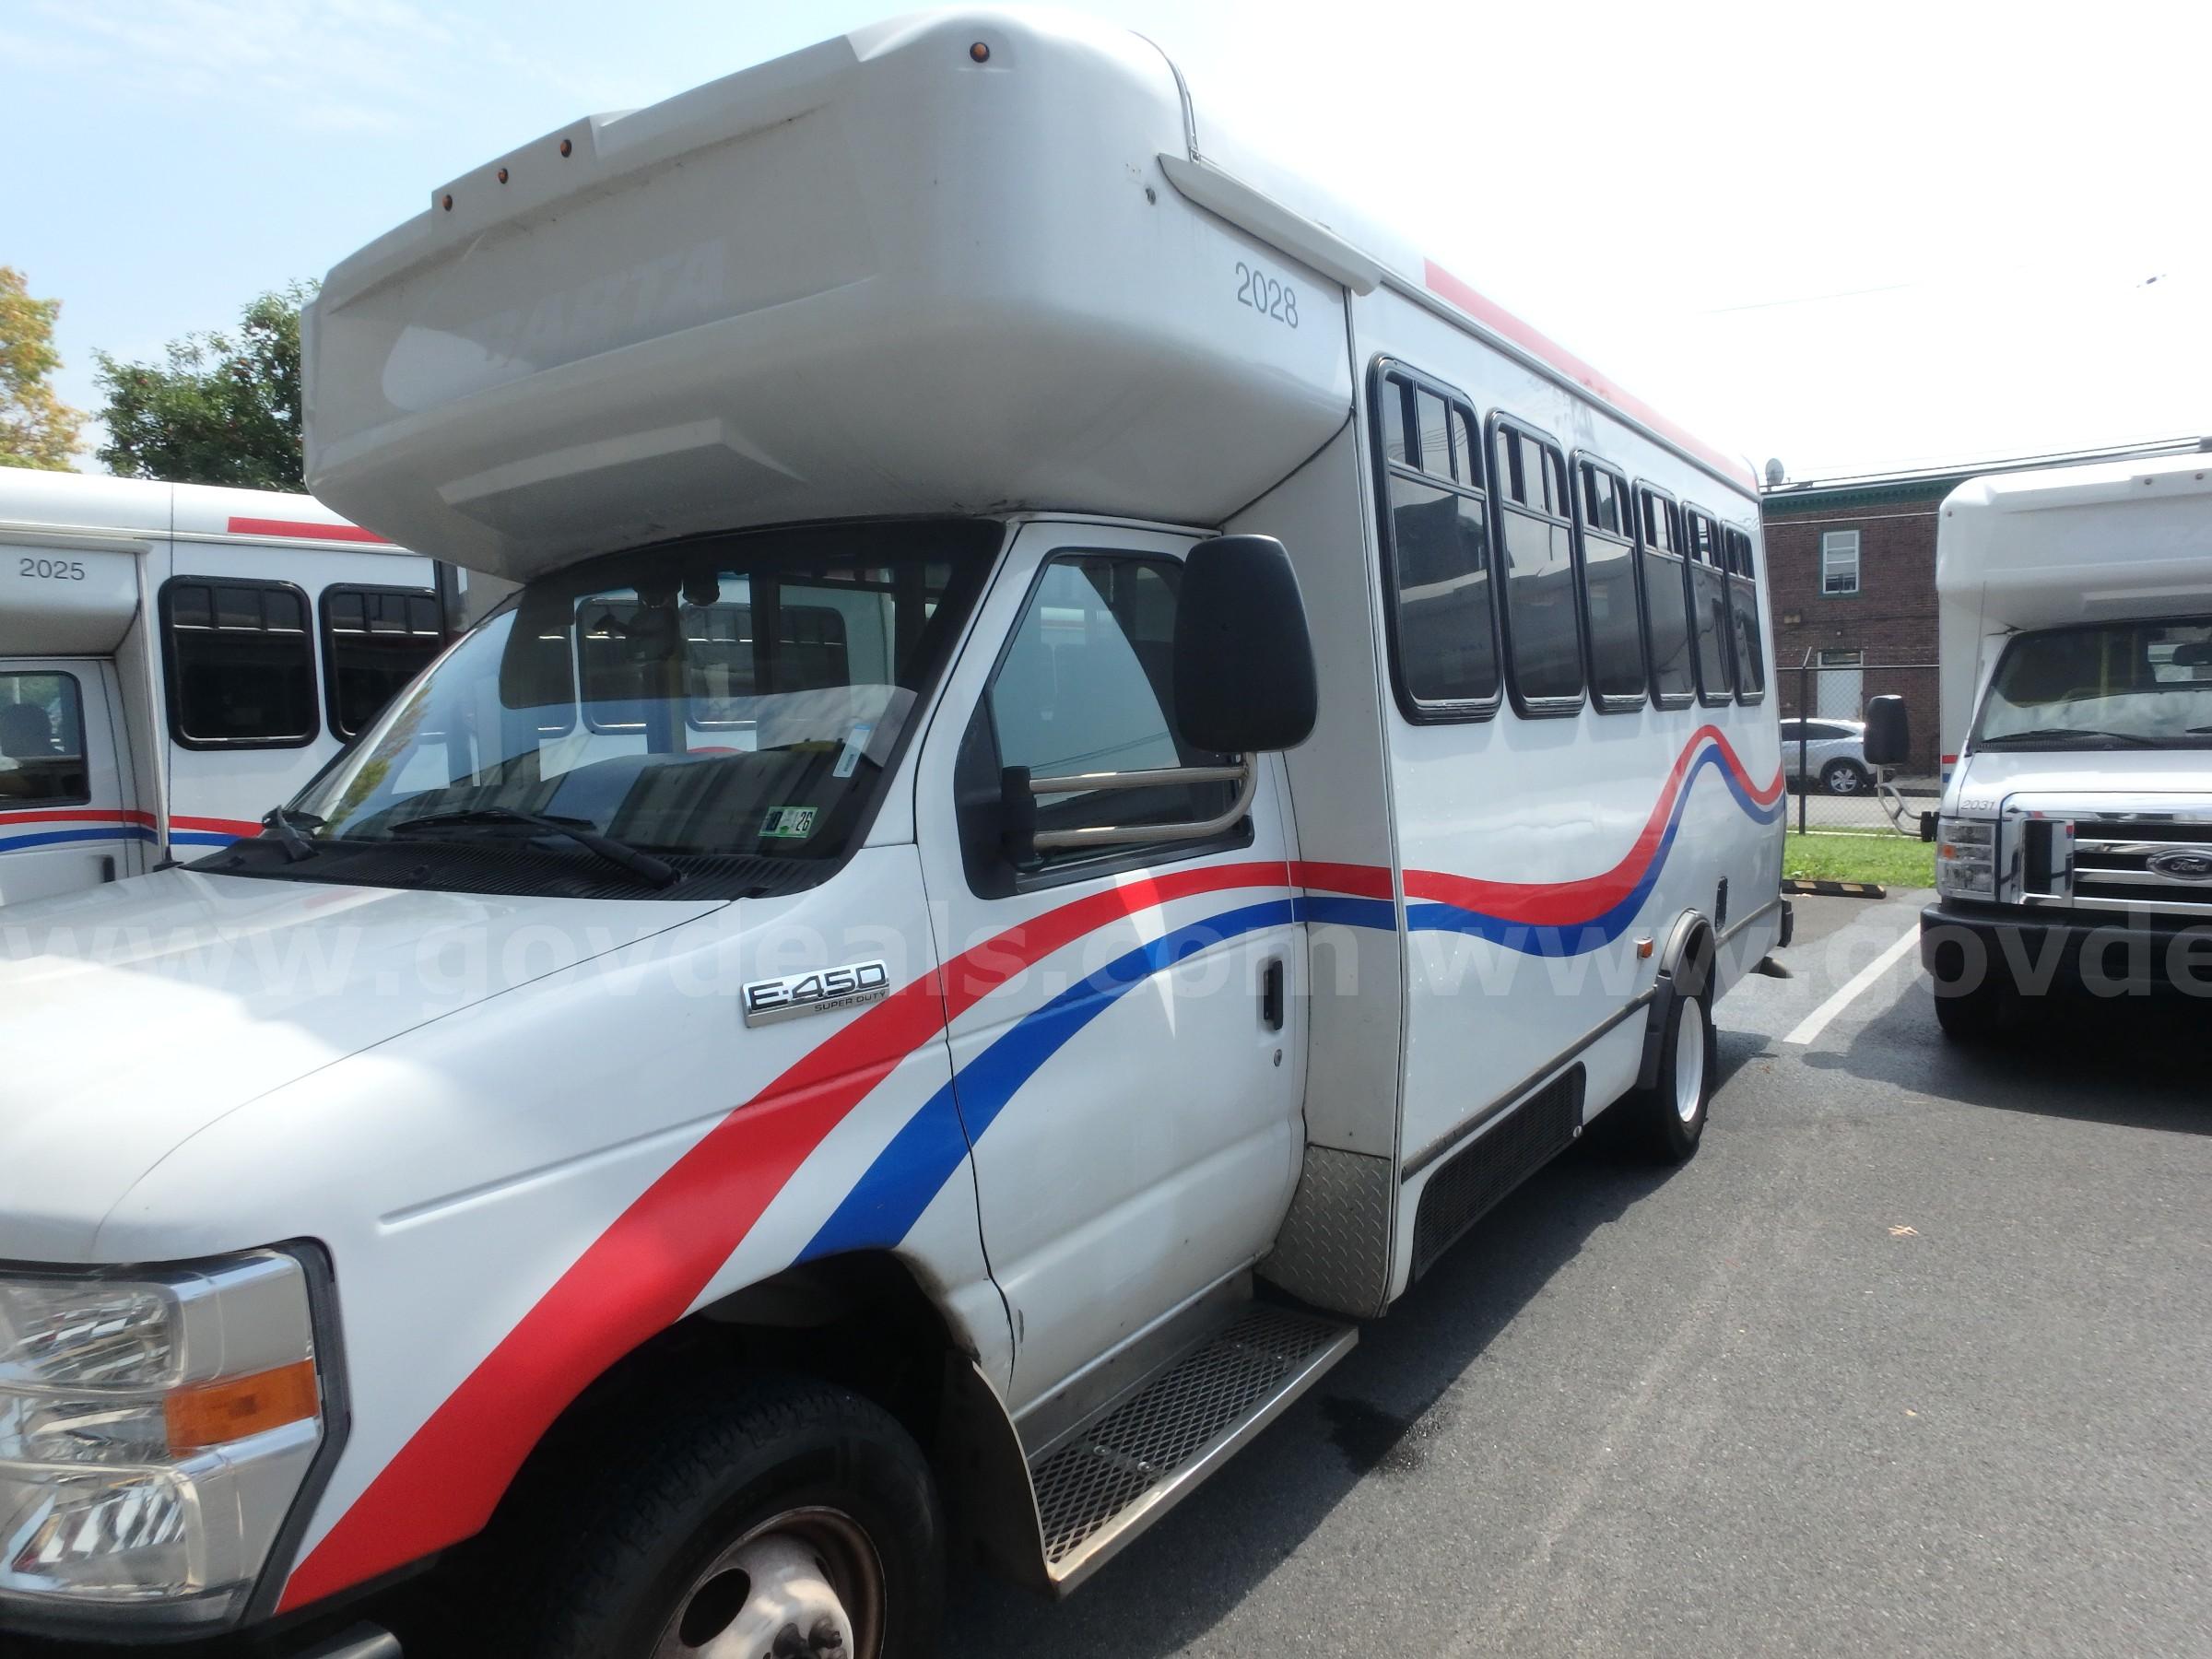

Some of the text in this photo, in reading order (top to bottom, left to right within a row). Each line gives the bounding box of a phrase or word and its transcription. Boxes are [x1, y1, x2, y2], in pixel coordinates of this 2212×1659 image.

[1235, 261, 1299, 329] 2028
[20, 558, 85, 581] 2025
[1960, 799, 1995, 811] 2031
[795, 811, 813, 831] 26
[2170, 859, 2208, 872] Ford
[814, 991, 887, 1012] SUPER DUTY
